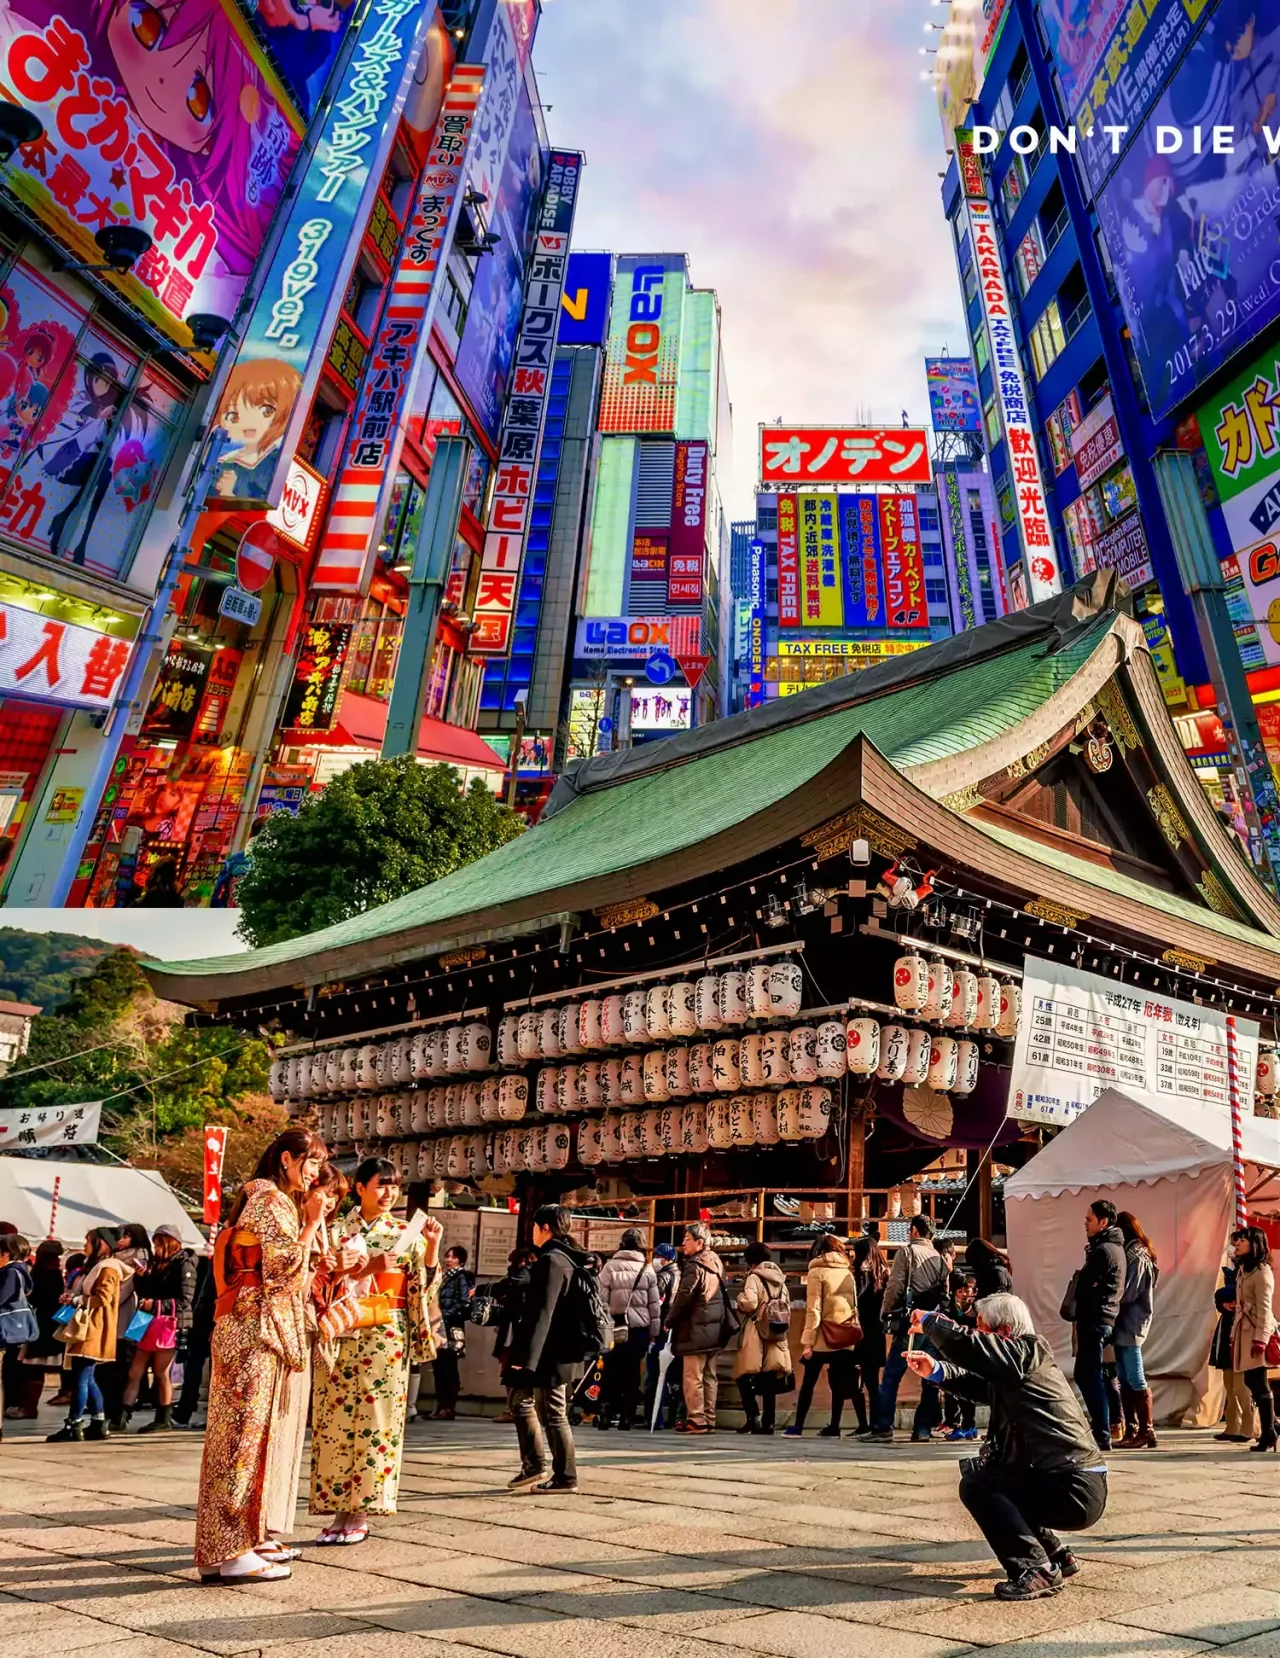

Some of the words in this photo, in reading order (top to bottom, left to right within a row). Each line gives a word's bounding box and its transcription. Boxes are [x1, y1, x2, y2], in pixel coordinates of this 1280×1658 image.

[8, 14, 218, 280] まどかマギカ
[437, 116, 470, 166] 買取り
[541, 154, 566, 229] PARADISE
[561, 156, 579, 205] HOBBY
[408, 192, 450, 263] まっくす
[970, 223, 1007, 316] TAKARADA
[1175, 245, 1214, 299] Fate
[353, 321, 420, 467] アキバ駅前店
[998, 370, 1028, 424] 免税商店
[684, 446, 706, 485] Duty
[765, 431, 924, 474] オノデン
[675, 482, 683, 507] Store
[684, 488, 705, 527] Free
[780, 499, 795, 533] 免税
[780, 534, 796, 568] TAX
[1104, 525, 1125, 547] English
[1108, 528, 1144, 564] COMPUTER
[672, 559, 699, 573] 免税
[803, 499, 821, 620] 都内・近郊送料無料
[845, 508, 861, 604] お見積り無料です
[1118, 549, 1149, 575] MOBILE
[751, 546, 764, 610] Panasonic
[781, 572, 797, 619] FREE
[894, 610, 920, 624] 4F
[583, 646, 605, 654] Home
[607, 646, 647, 654] Electronics
[649, 646, 669, 654] Store
[752, 618, 762, 674] ONODEN
[785, 643, 811, 654] TAX
[814, 643, 849, 654] FREE
[851, 643, 881, 654] 免税店
[211, 656, 240, 681] 入口
[684, 662, 703, 670] 止まれ
[1035, 1015, 1053, 1027] 25歳
[1037, 1000, 1053, 1011] 男性
[1105, 991, 1142, 1014] 平成27年
[1143, 1000, 1173, 1023] 厄年表
[1033, 1034, 1051, 1045] 42歳
[1161, 1046, 1174, 1057] 19歳
[713, 1045, 727, 1080] 柏木
[1031, 1052, 1050, 1063] 61歳
[1160, 1063, 1173, 1074] 33歳
[1160, 1079, 1173, 1090] 37歳
[1040, 1105, 1055, 1115] 61歳
